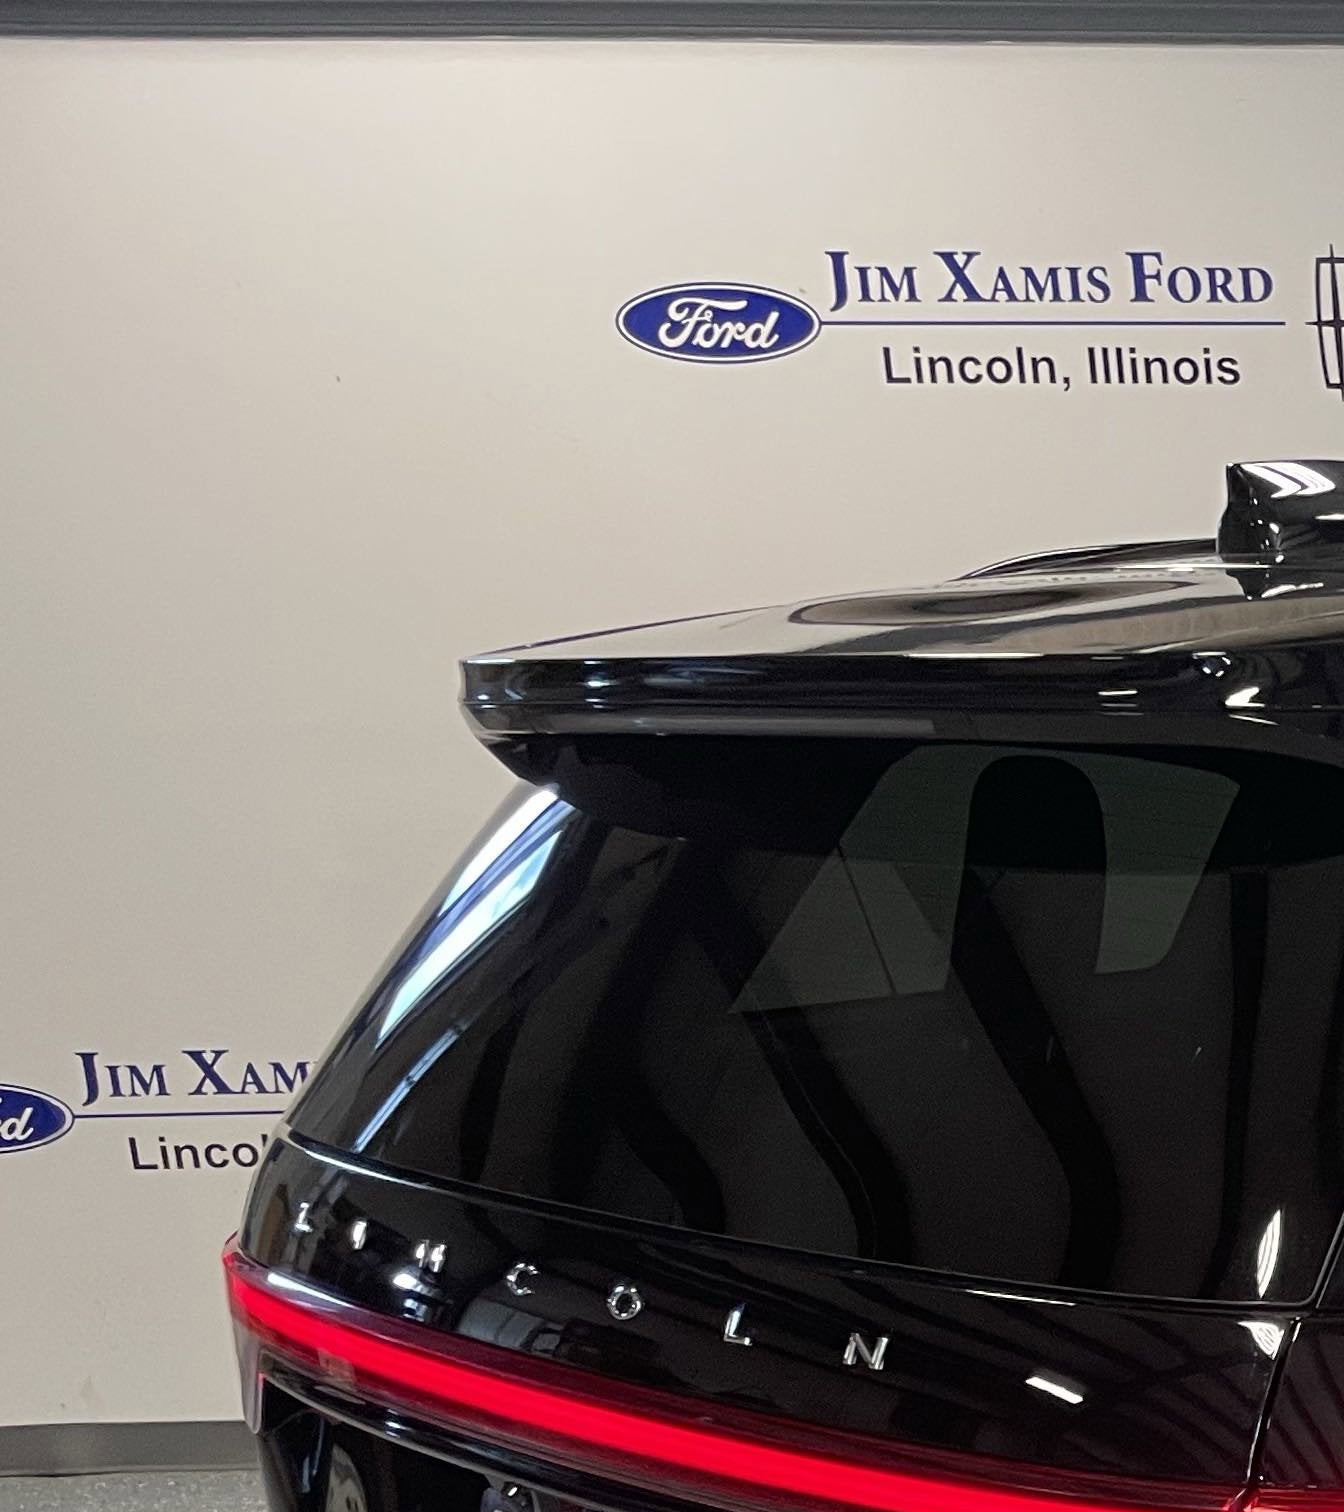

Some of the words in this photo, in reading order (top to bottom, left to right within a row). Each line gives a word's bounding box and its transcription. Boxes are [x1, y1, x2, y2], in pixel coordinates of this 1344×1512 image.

[824, 251, 922, 312] JIM
[933, 251, 1111, 304] XAMIS
[1125, 252, 1273, 304] FORD
[657, 297, 779, 350] Ford
[883, 346, 1070, 391] Lincoln,
[1088, 346, 1241, 386] Illinois
[75, 1051, 171, 1107] JIM
[182, 1049, 319, 1096] XAM
